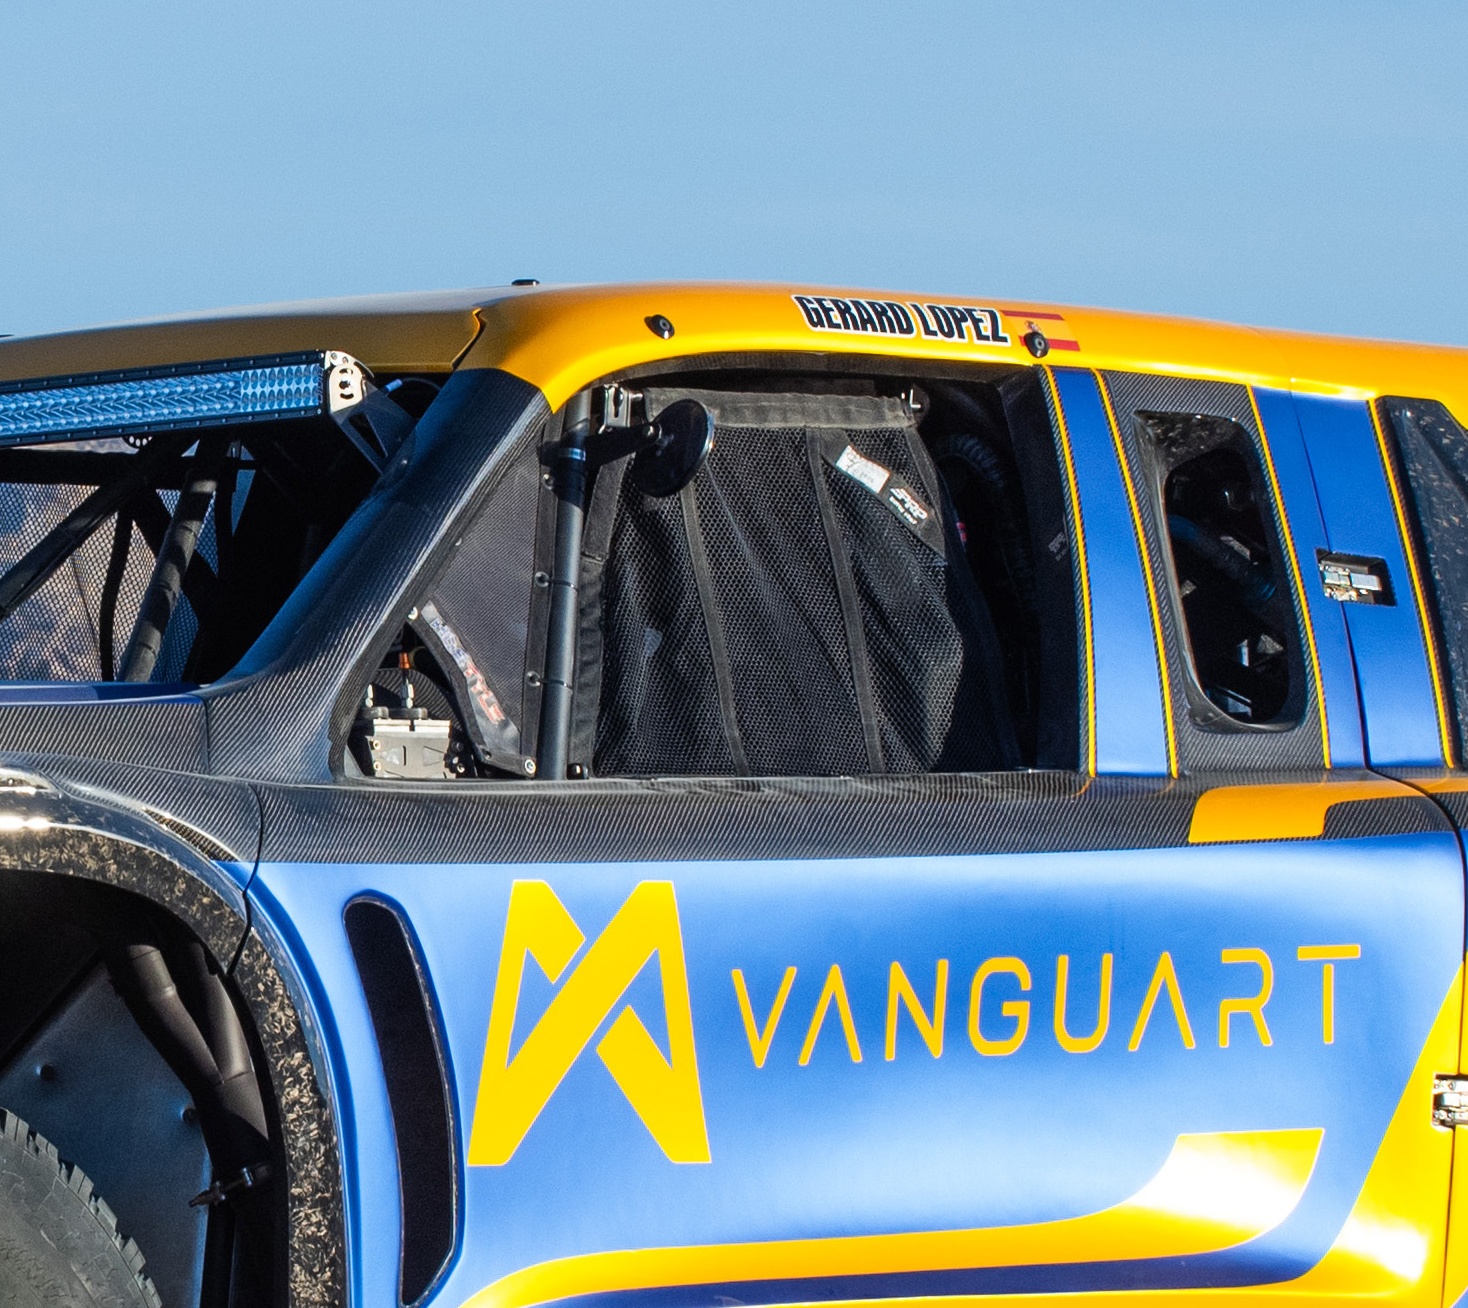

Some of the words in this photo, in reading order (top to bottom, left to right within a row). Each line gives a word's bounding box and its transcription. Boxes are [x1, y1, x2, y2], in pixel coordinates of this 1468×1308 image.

[792, 295, 916, 336] GERARD
[908, 302, 1011, 344] LOPEZ
[731, 943, 1361, 1069] VANGUART
